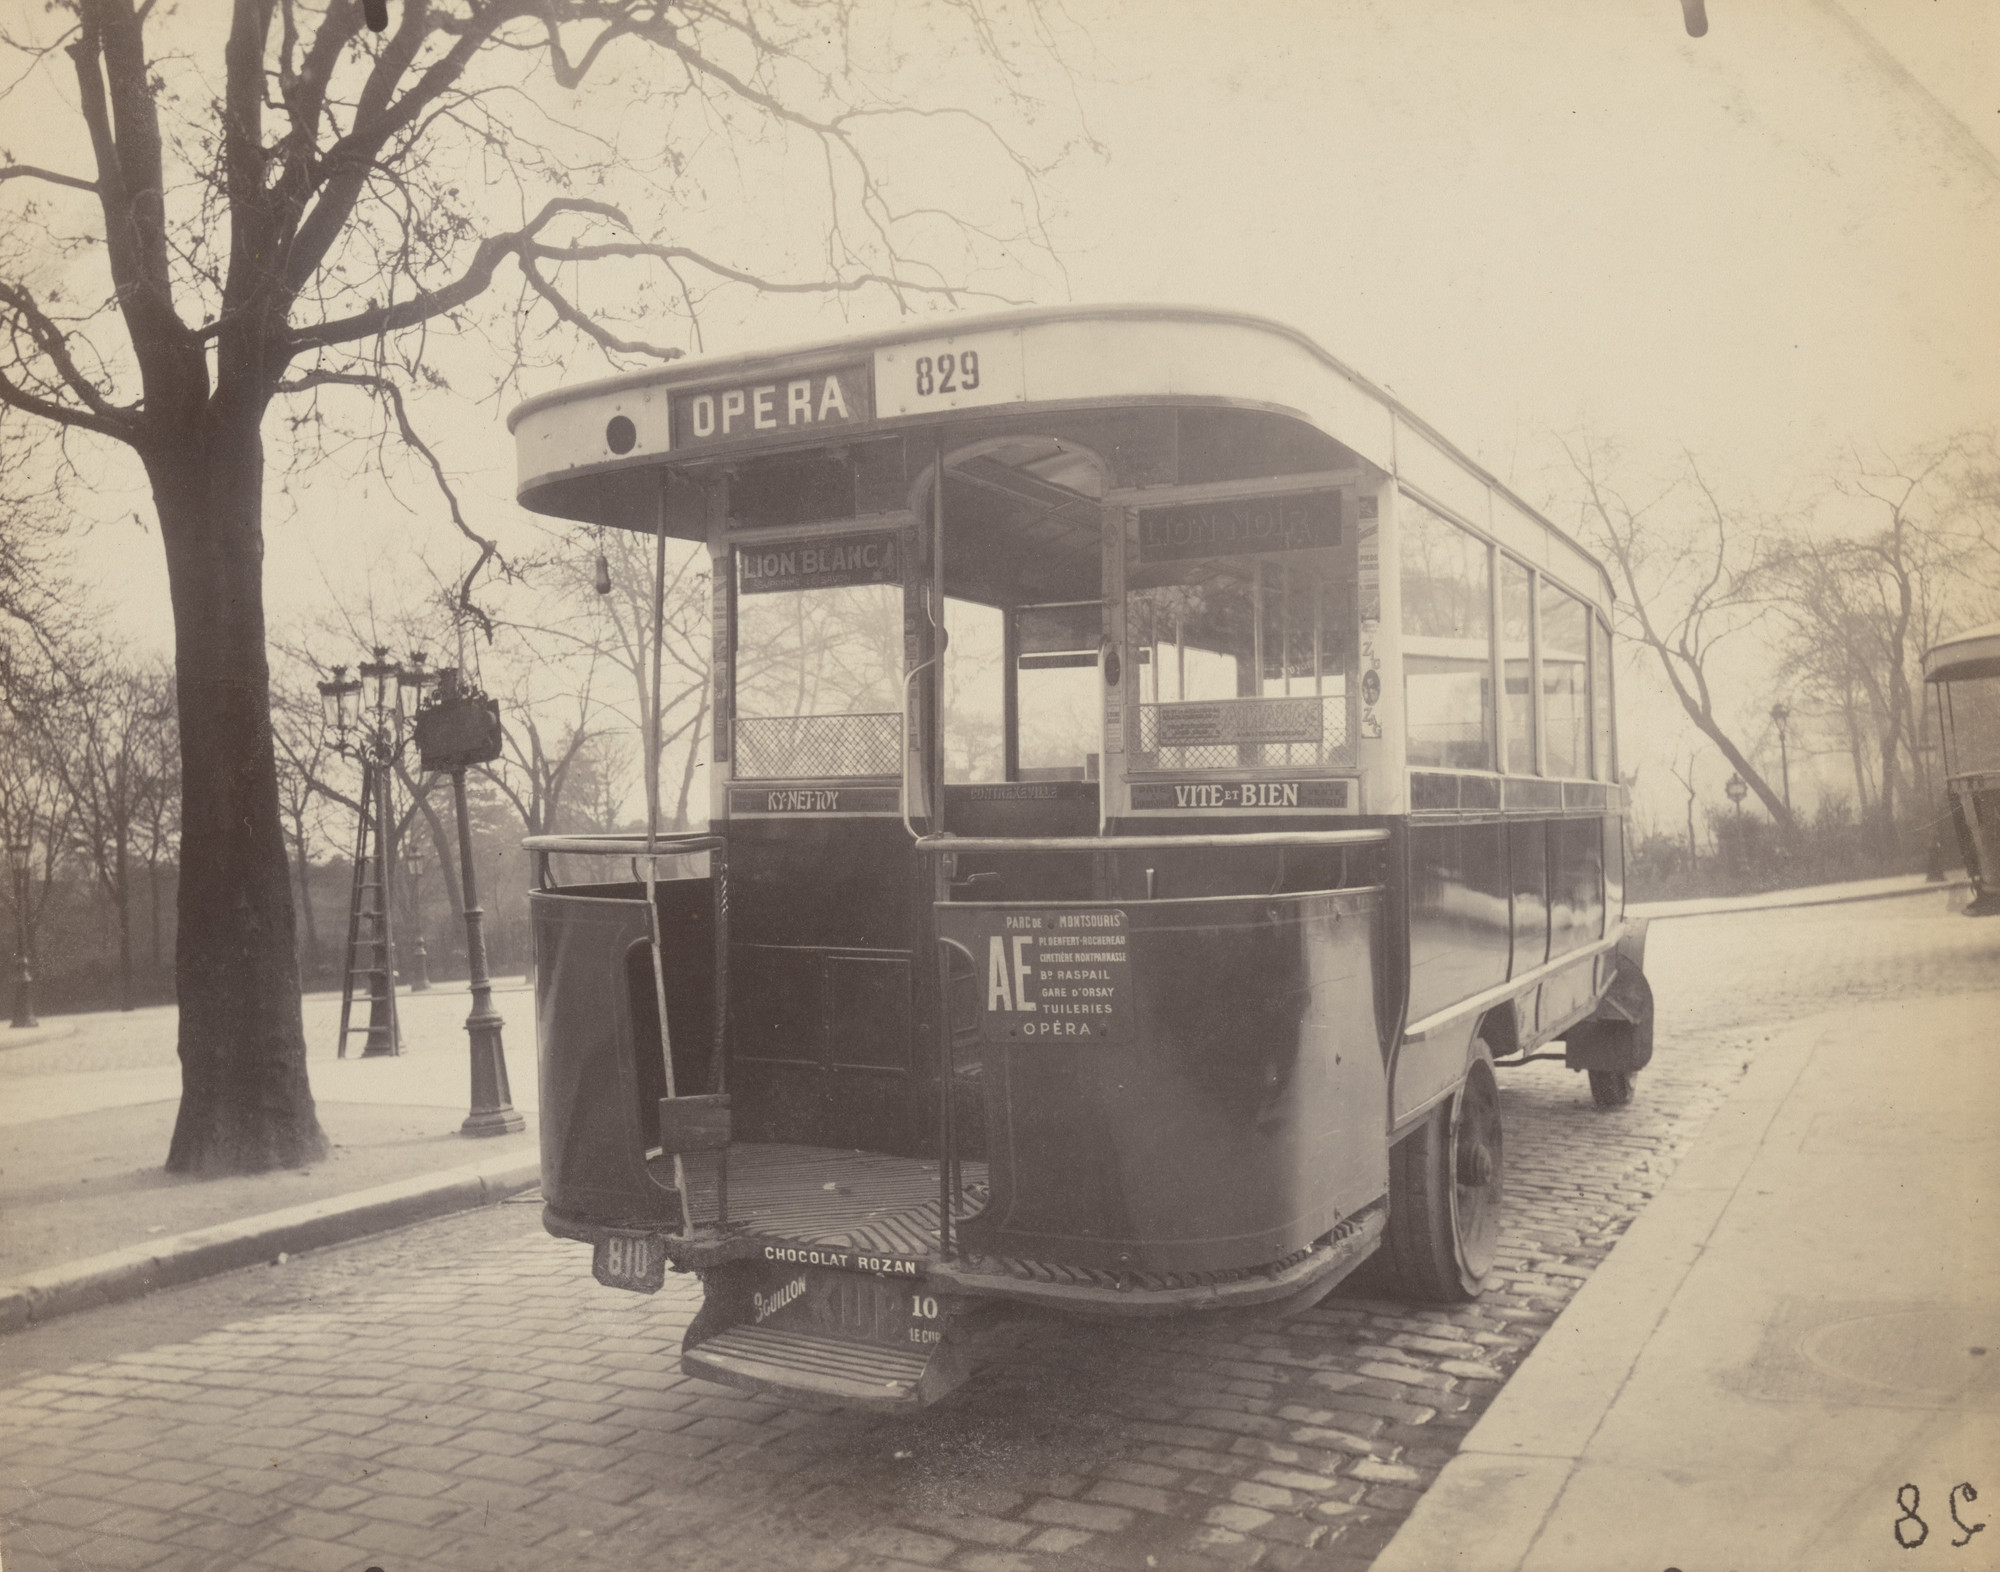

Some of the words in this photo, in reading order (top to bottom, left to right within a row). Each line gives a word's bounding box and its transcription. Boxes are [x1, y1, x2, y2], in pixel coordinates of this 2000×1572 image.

[916, 350, 980, 396] 829
[692, 375, 849, 437] OPERA
[743, 551, 796, 579] LION
[802, 544, 878, 574] BLANC
[1175, 784, 1224, 807] VITE
[1225, 790, 1239, 800] ET
[1241, 783, 1299, 806] BIEN
[1006, 916, 1031, 928] PARC
[1032, 918, 1042, 928] DE
[1059, 915, 1121, 928] MONTSOURIS
[1075, 952, 1127, 963] MONTPARNASSE
[988, 936, 1037, 1011] AE
[1057, 970, 1111, 980] RASPAIL
[1042, 988, 1067, 997] GARE
[1072, 987, 1114, 997] D'ORSAY
[1043, 1004, 1113, 1014] TUILERIES
[1023, 1020, 1091, 1035] OPÉRA
[765, 1246, 848, 1268] CHOCOLAT
[858, 1256, 916, 1275] ROZAN
[912, 1295, 938, 1319] 10
[909, 1327, 921, 1343] LE
